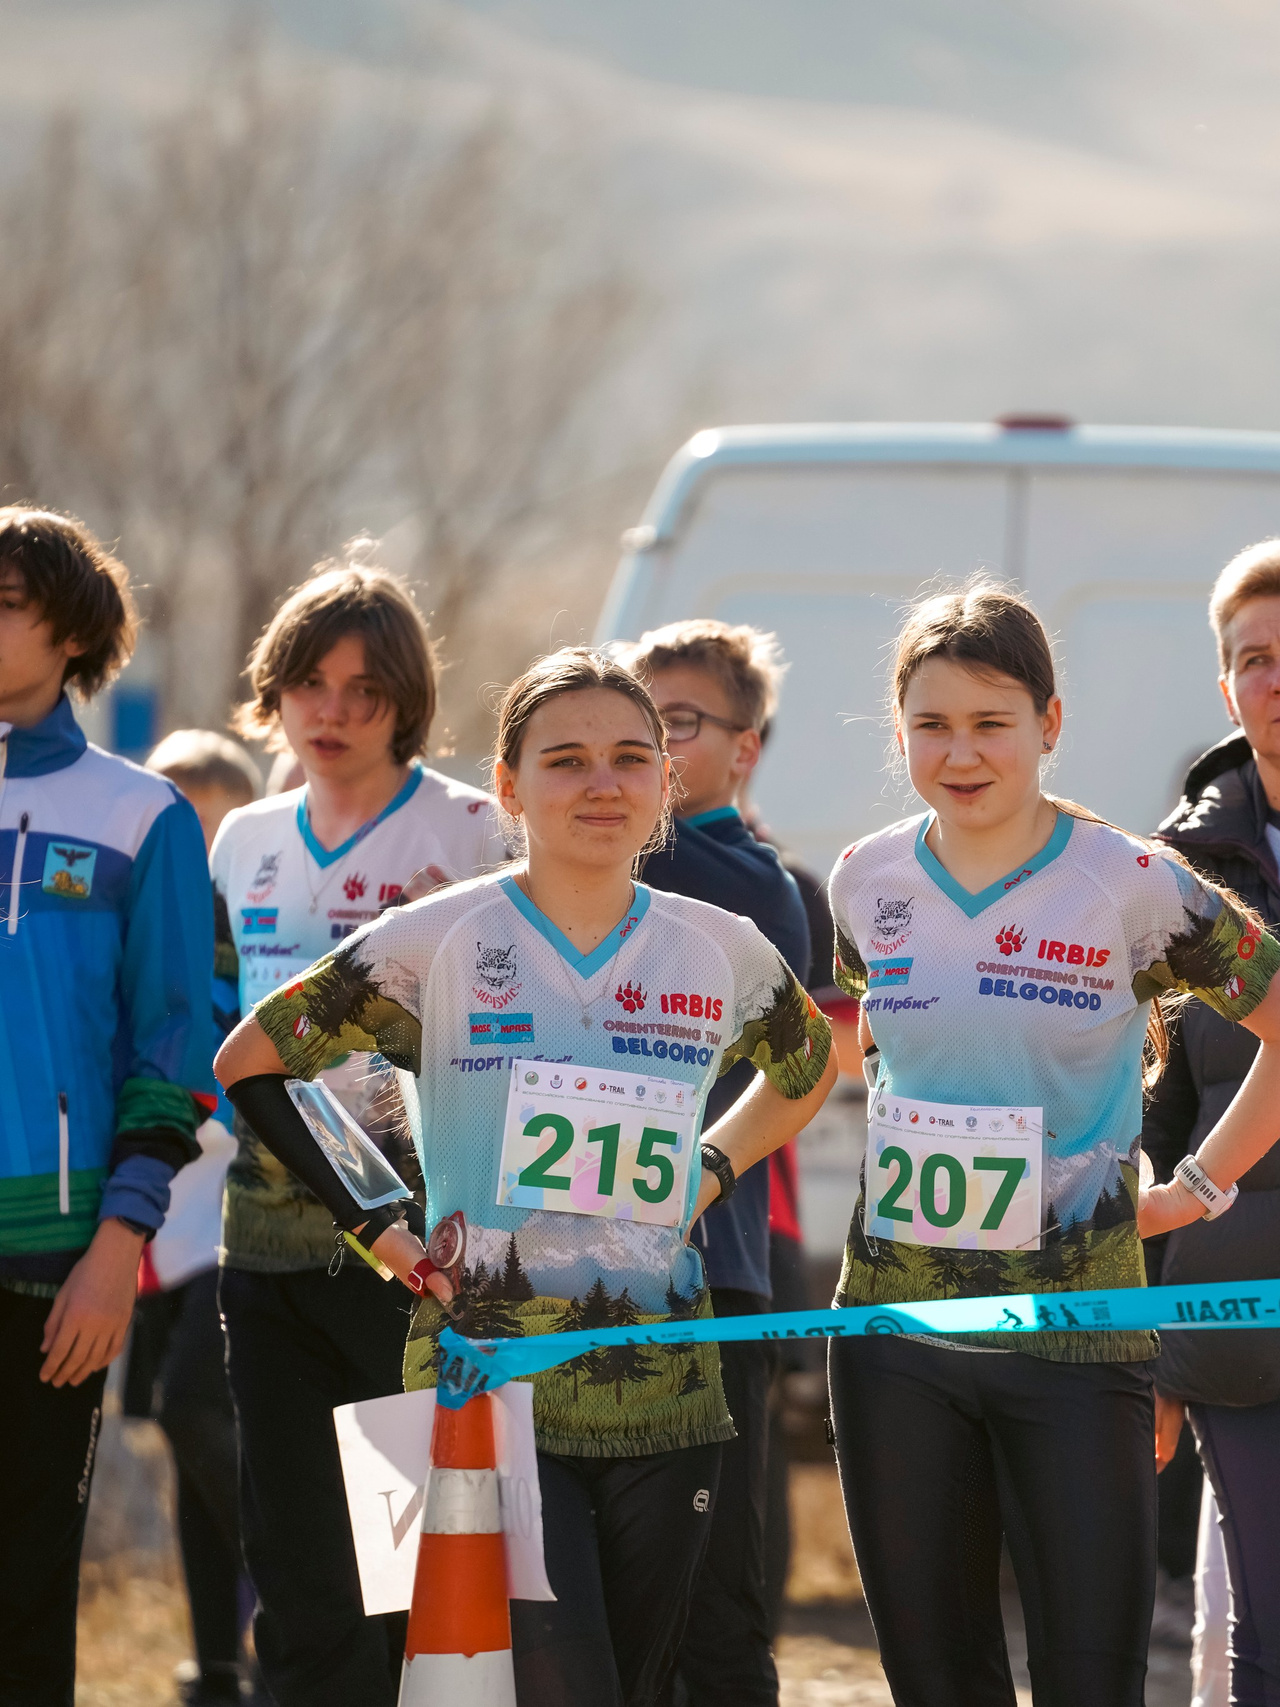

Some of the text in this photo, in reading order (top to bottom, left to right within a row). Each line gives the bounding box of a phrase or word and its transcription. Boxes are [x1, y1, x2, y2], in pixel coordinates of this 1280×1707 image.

[1038, 939, 1111, 968] IRBIS
[976, 961, 1114, 991] ORIENTEERING TEAM
[660, 993, 723, 1022] IRBIS
[979, 977, 1102, 1011] BELGOROD
[602, 1020, 702, 1041] ORIENTEERING
[518, 1113, 678, 1205] 215
[877, 1145, 1027, 1231] 207
